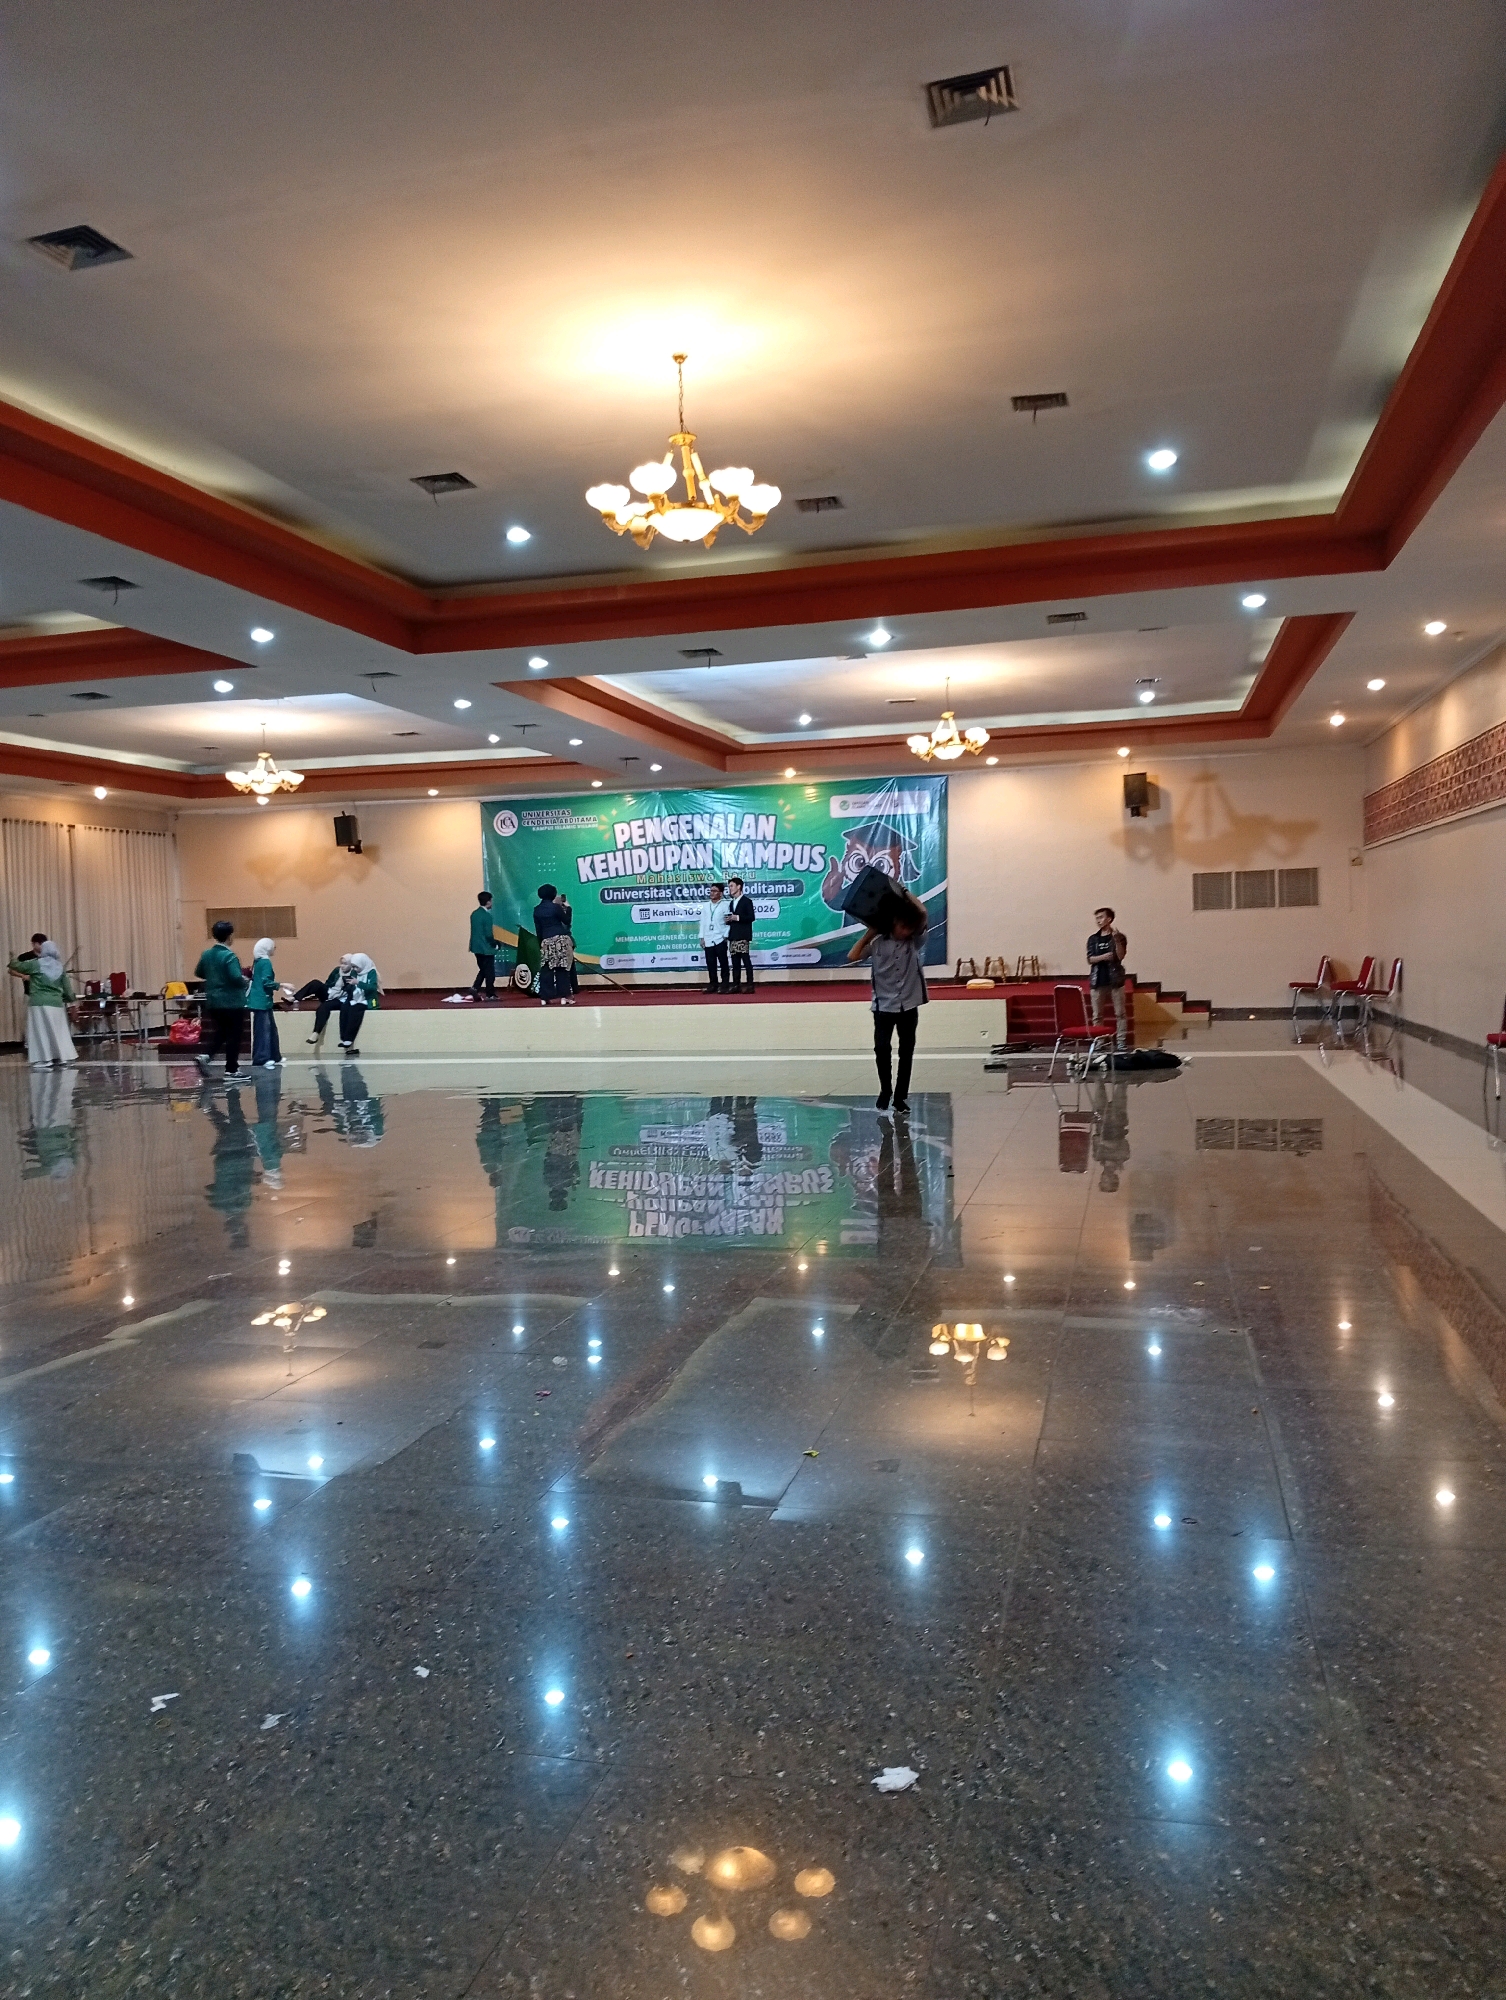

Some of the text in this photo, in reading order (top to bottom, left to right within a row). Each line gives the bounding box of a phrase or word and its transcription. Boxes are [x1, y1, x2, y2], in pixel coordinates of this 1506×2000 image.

[522, 809, 571, 818] UNIVERSITAS
[522, 815, 599, 826] CENDEKIA ABDITAMA
[613, 812, 777, 849] PENGENALAN
[576, 842, 827, 884] KEHIDUPAN KAMPUS
[636, 871, 756, 885] Mahasiswa Baru
[604, 881, 795, 901] Universitas Cendea bditama
[652, 908, 683, 918] Kamis,
[684, 908, 694, 916] 10
[752, 906, 775, 914] 2026
[615, 934, 657, 943] MEMBANGUN
[657, 933, 688, 941] GENERASI
